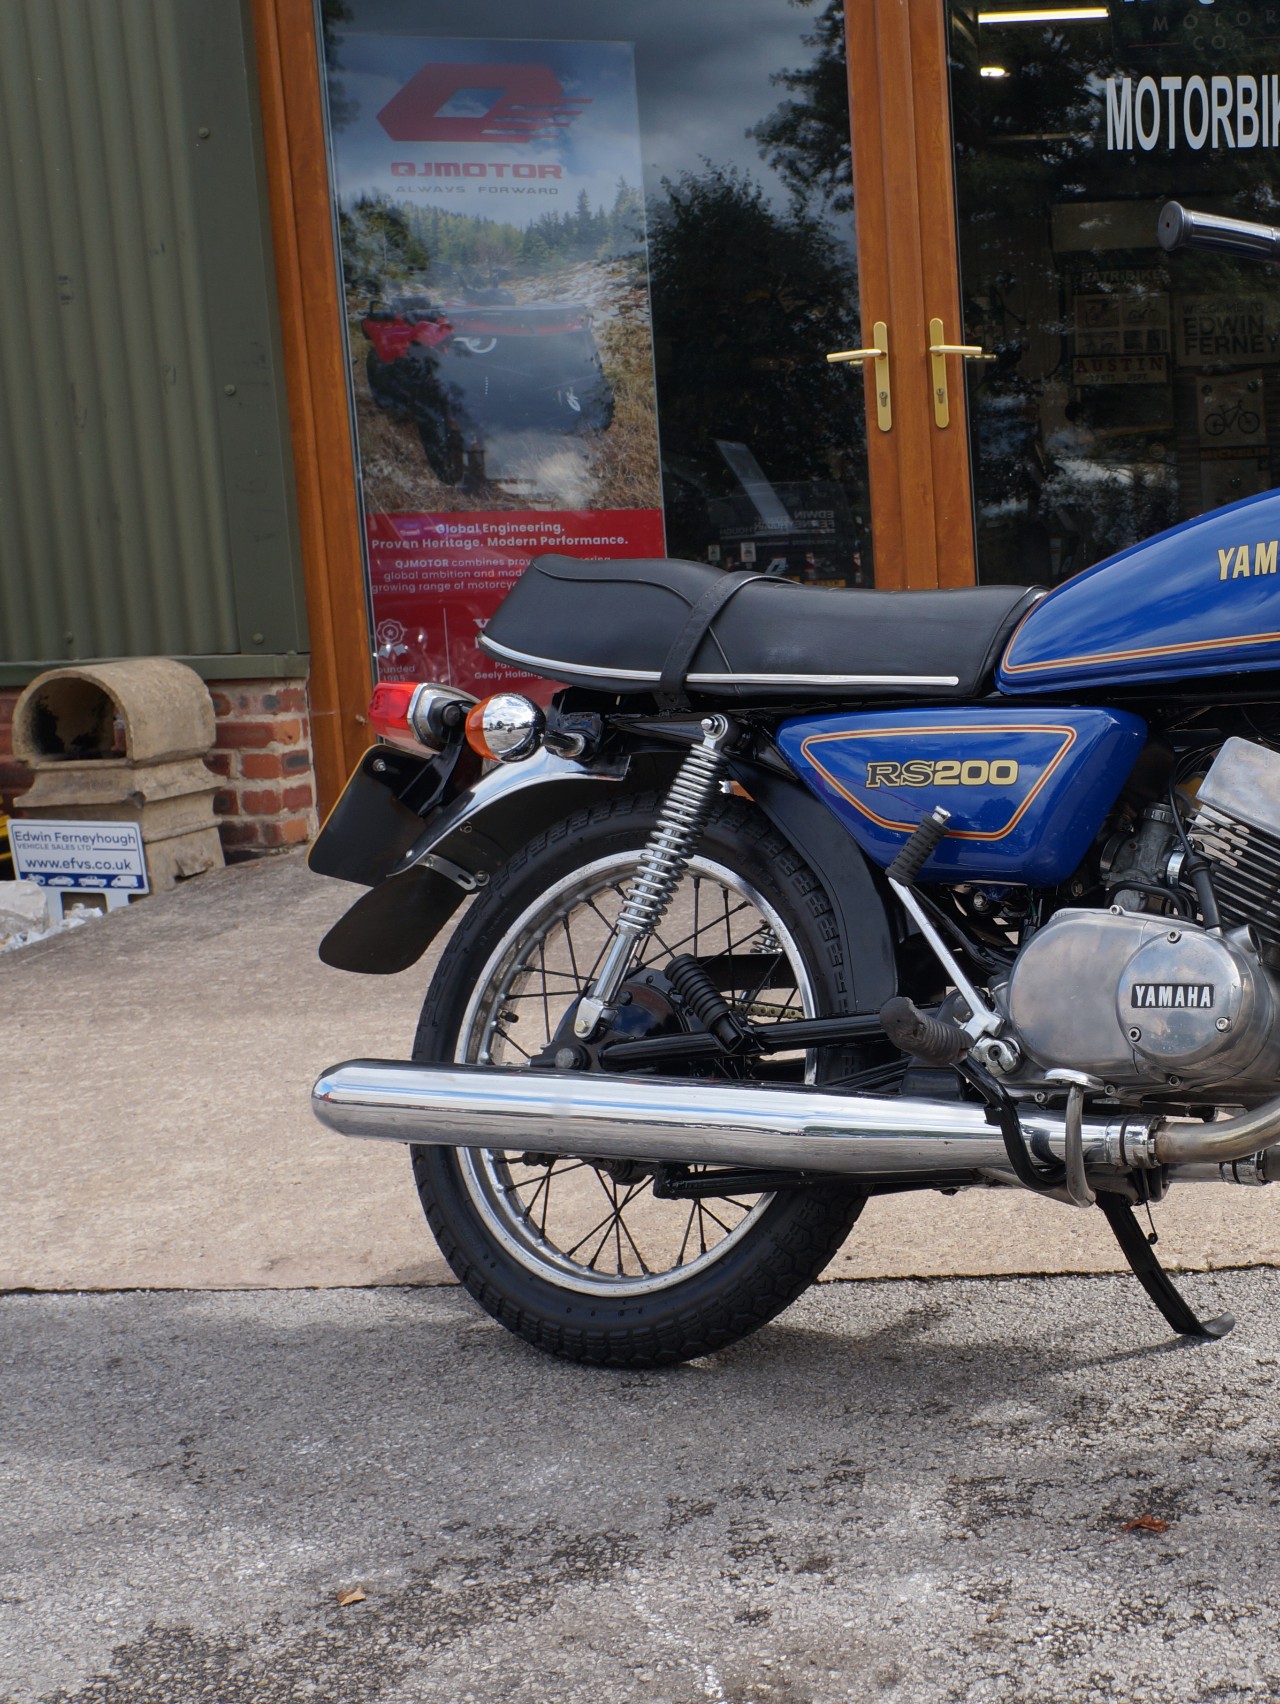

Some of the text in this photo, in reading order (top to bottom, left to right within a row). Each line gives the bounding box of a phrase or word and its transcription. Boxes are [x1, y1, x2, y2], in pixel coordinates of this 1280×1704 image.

[391, 162, 562, 179] QJMOTOR
[395, 185, 559, 195] ALWAYS FORWARD
[1184, 315, 1264, 336] EDWIN
[1075, 357, 1164, 373] AUSTIN
[435, 522, 565, 535] Global Engineering.
[372, 535, 628, 550] Proven Heritage. Modern Performance.
[395, 558, 531, 569] QJMOTOR combines prov
[384, 569, 525, 581] global ambition and mod
[372, 583, 416, 594] growing
[418, 583, 451, 592] range
[454, 581, 465, 590] of
[475, 671, 502, 680] Geely
[865, 759, 1019, 788] RS200
[14, 831, 136, 847] Edwin Ferneyhough
[25, 857, 132, 870] www.efvs.co.uk
[1135, 985, 1211, 1007] YAMAHA
